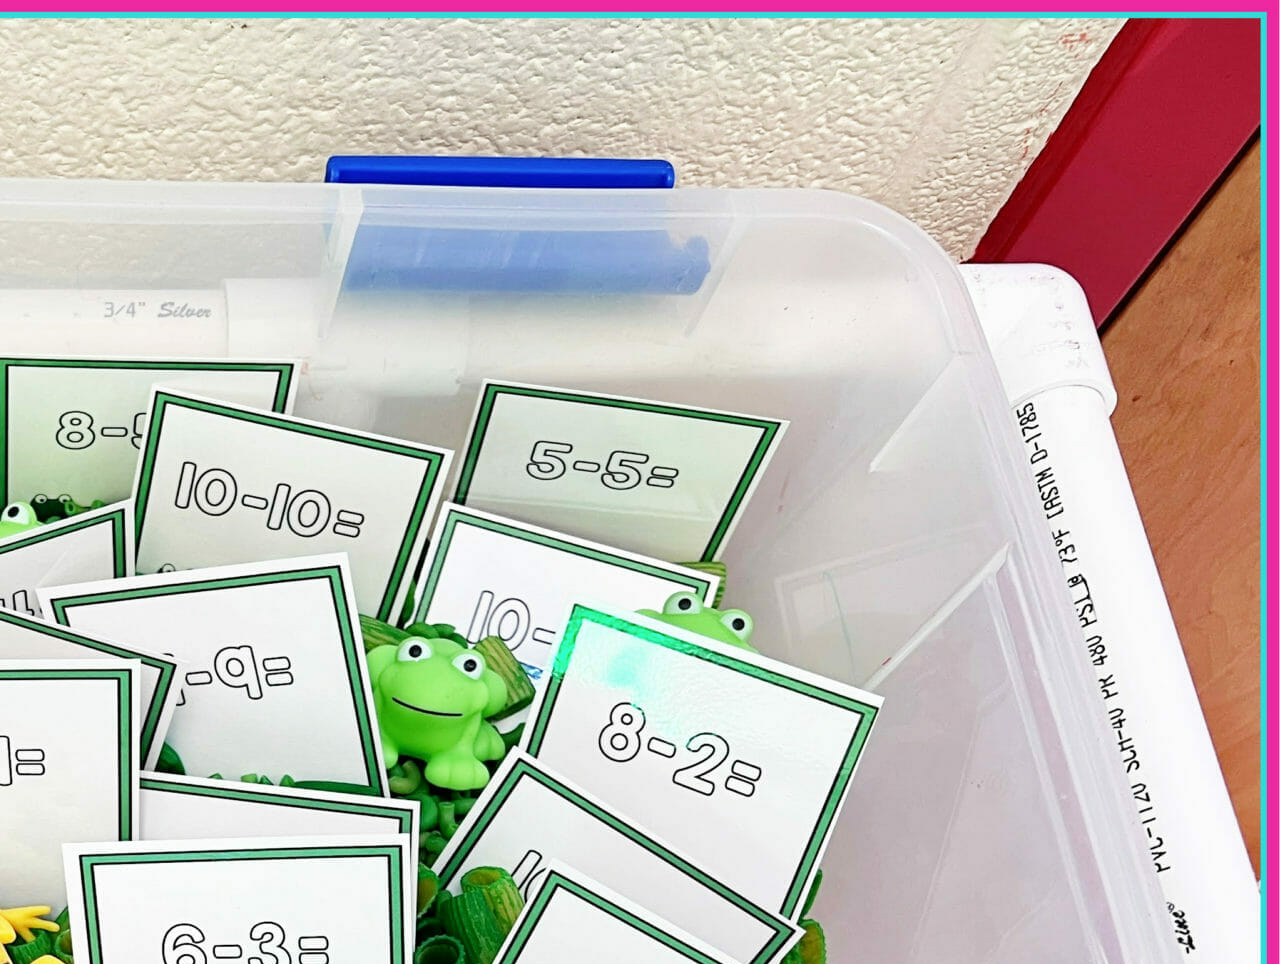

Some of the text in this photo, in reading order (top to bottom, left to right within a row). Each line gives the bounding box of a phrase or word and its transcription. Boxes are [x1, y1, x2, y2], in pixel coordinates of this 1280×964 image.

[157, 301, 213, 319] Silver
[1015, 402, 1049, 464] D-1785
[525, 440, 680, 490] 5-5=
[174, 461, 365, 538] 10-10=
[598, 701, 763, 797] 8-2=
